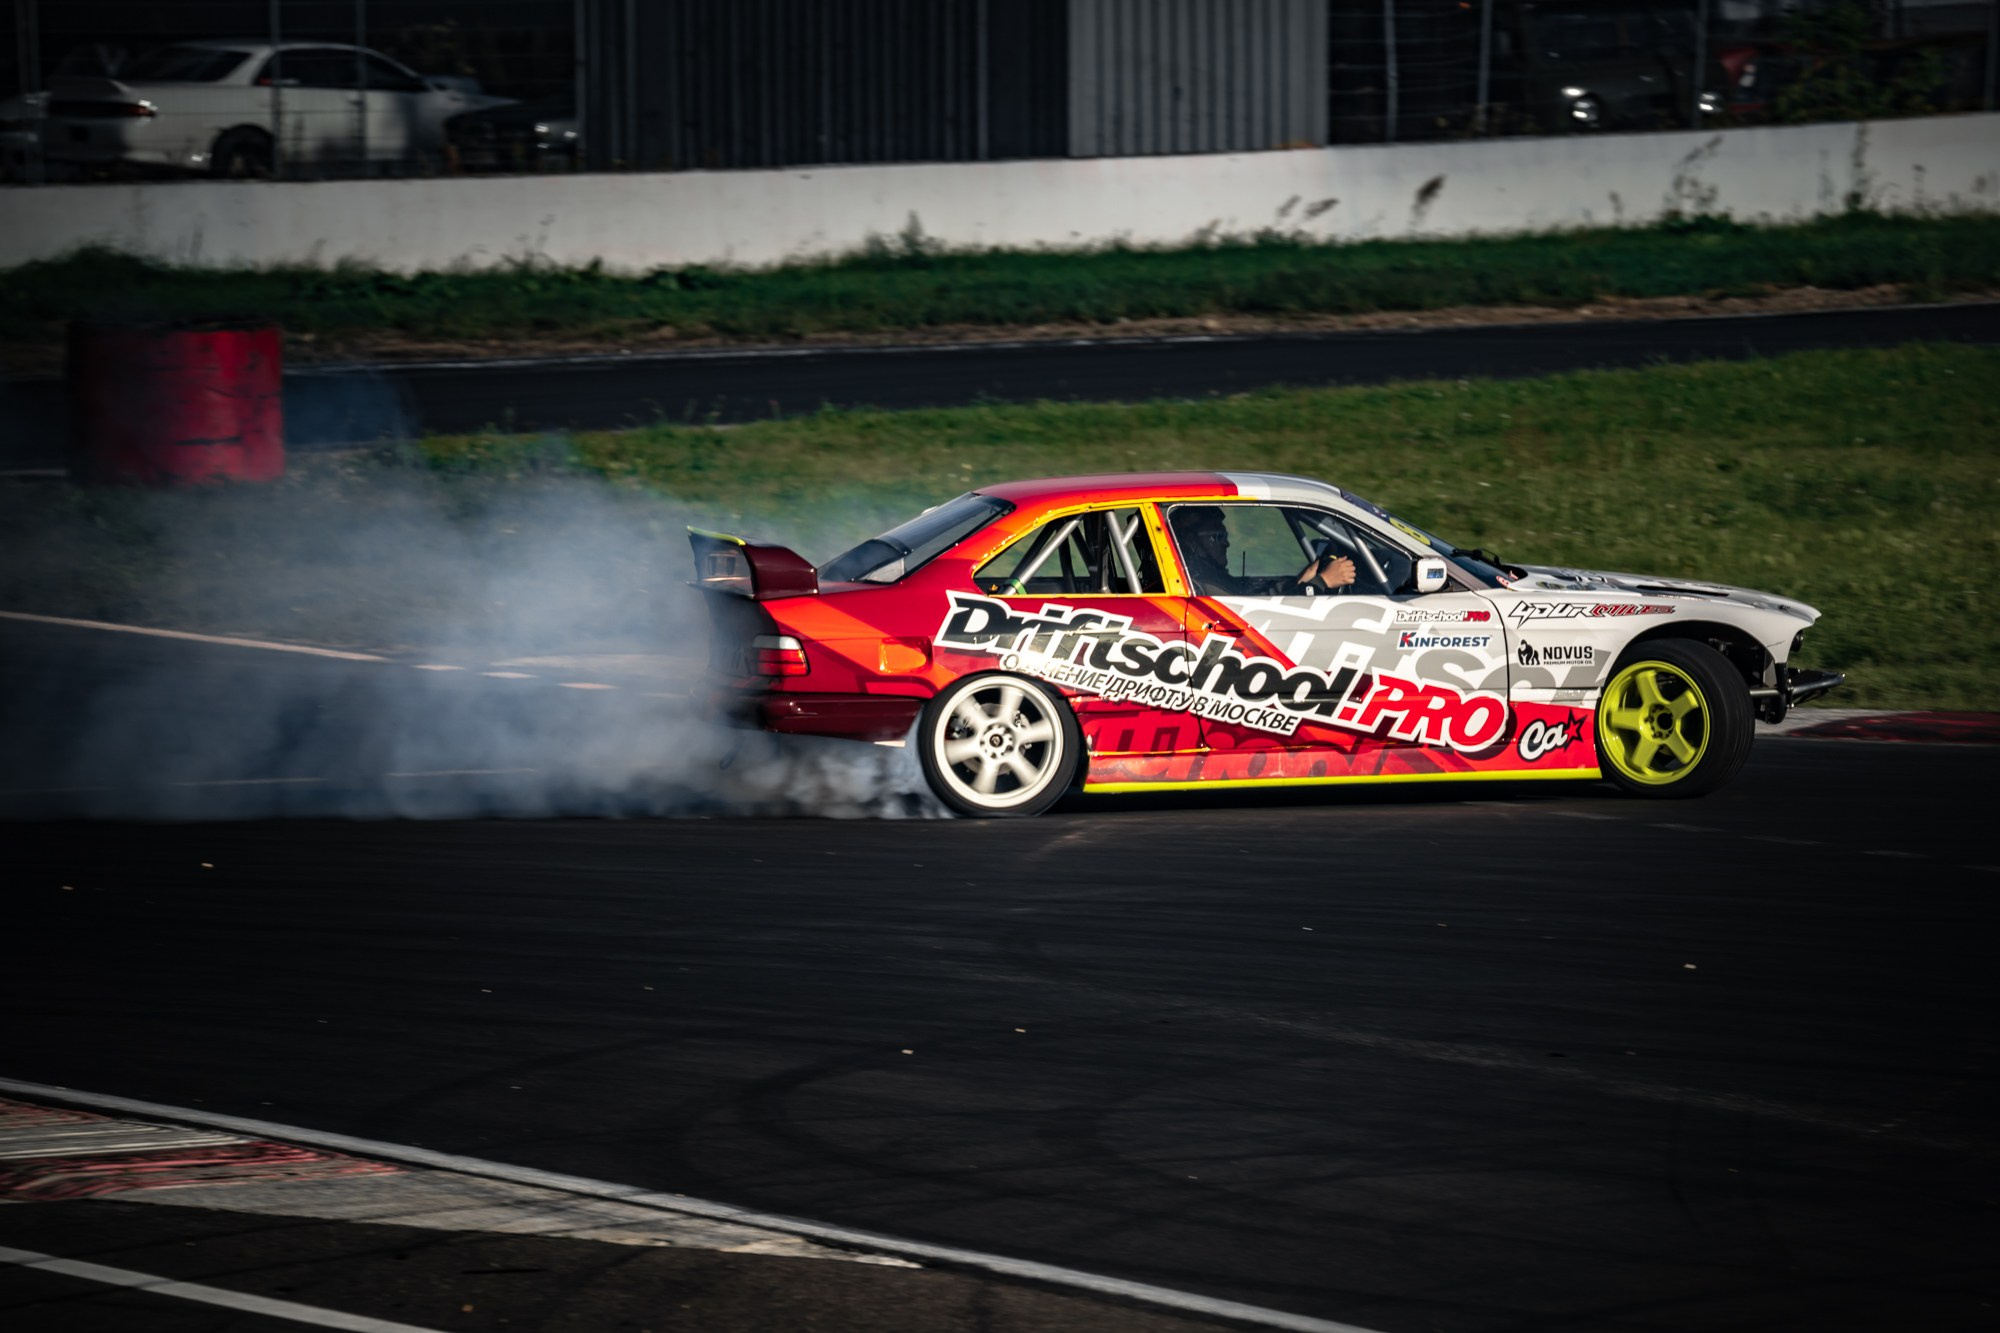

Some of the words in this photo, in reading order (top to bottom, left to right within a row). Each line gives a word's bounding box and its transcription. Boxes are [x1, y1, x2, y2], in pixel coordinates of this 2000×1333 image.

[1396, 610, 1491, 622] Driftschool.PRO
[1399, 631, 1491, 648] KINFOREST
[1543, 646, 1593, 660] NOVUS
[940, 595, 1506, 749] Driftschool.PRO
[1207, 699, 1298, 732] МОСКВЕ
